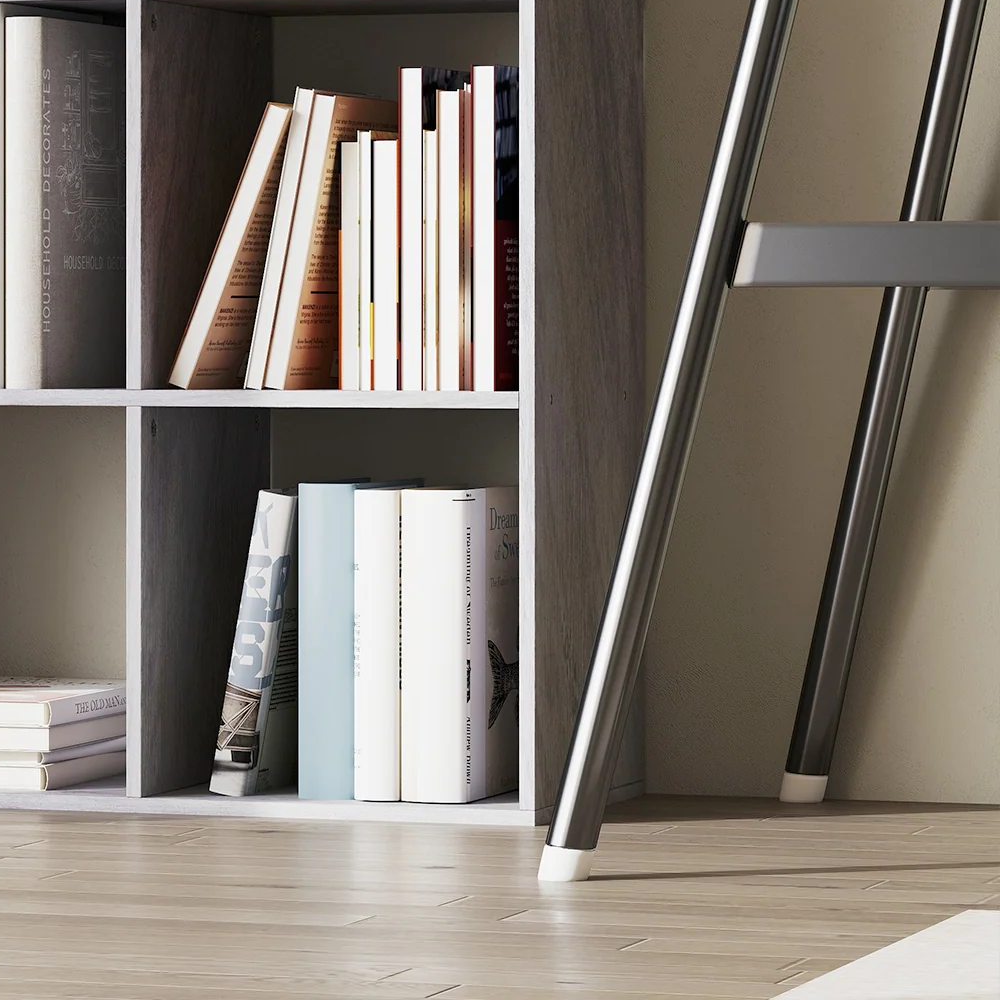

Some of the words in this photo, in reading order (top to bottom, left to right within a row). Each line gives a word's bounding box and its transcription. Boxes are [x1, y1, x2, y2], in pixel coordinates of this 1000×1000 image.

[42, 68, 51, 192] DECORATES
[42, 207, 51, 333] HOUSEHOLD
[63, 255, 104, 270] HOUSEHOLD
[75, 701, 89, 714] THE
[90, 698, 105, 712] OLD
[105, 694, 120, 709] MAN
